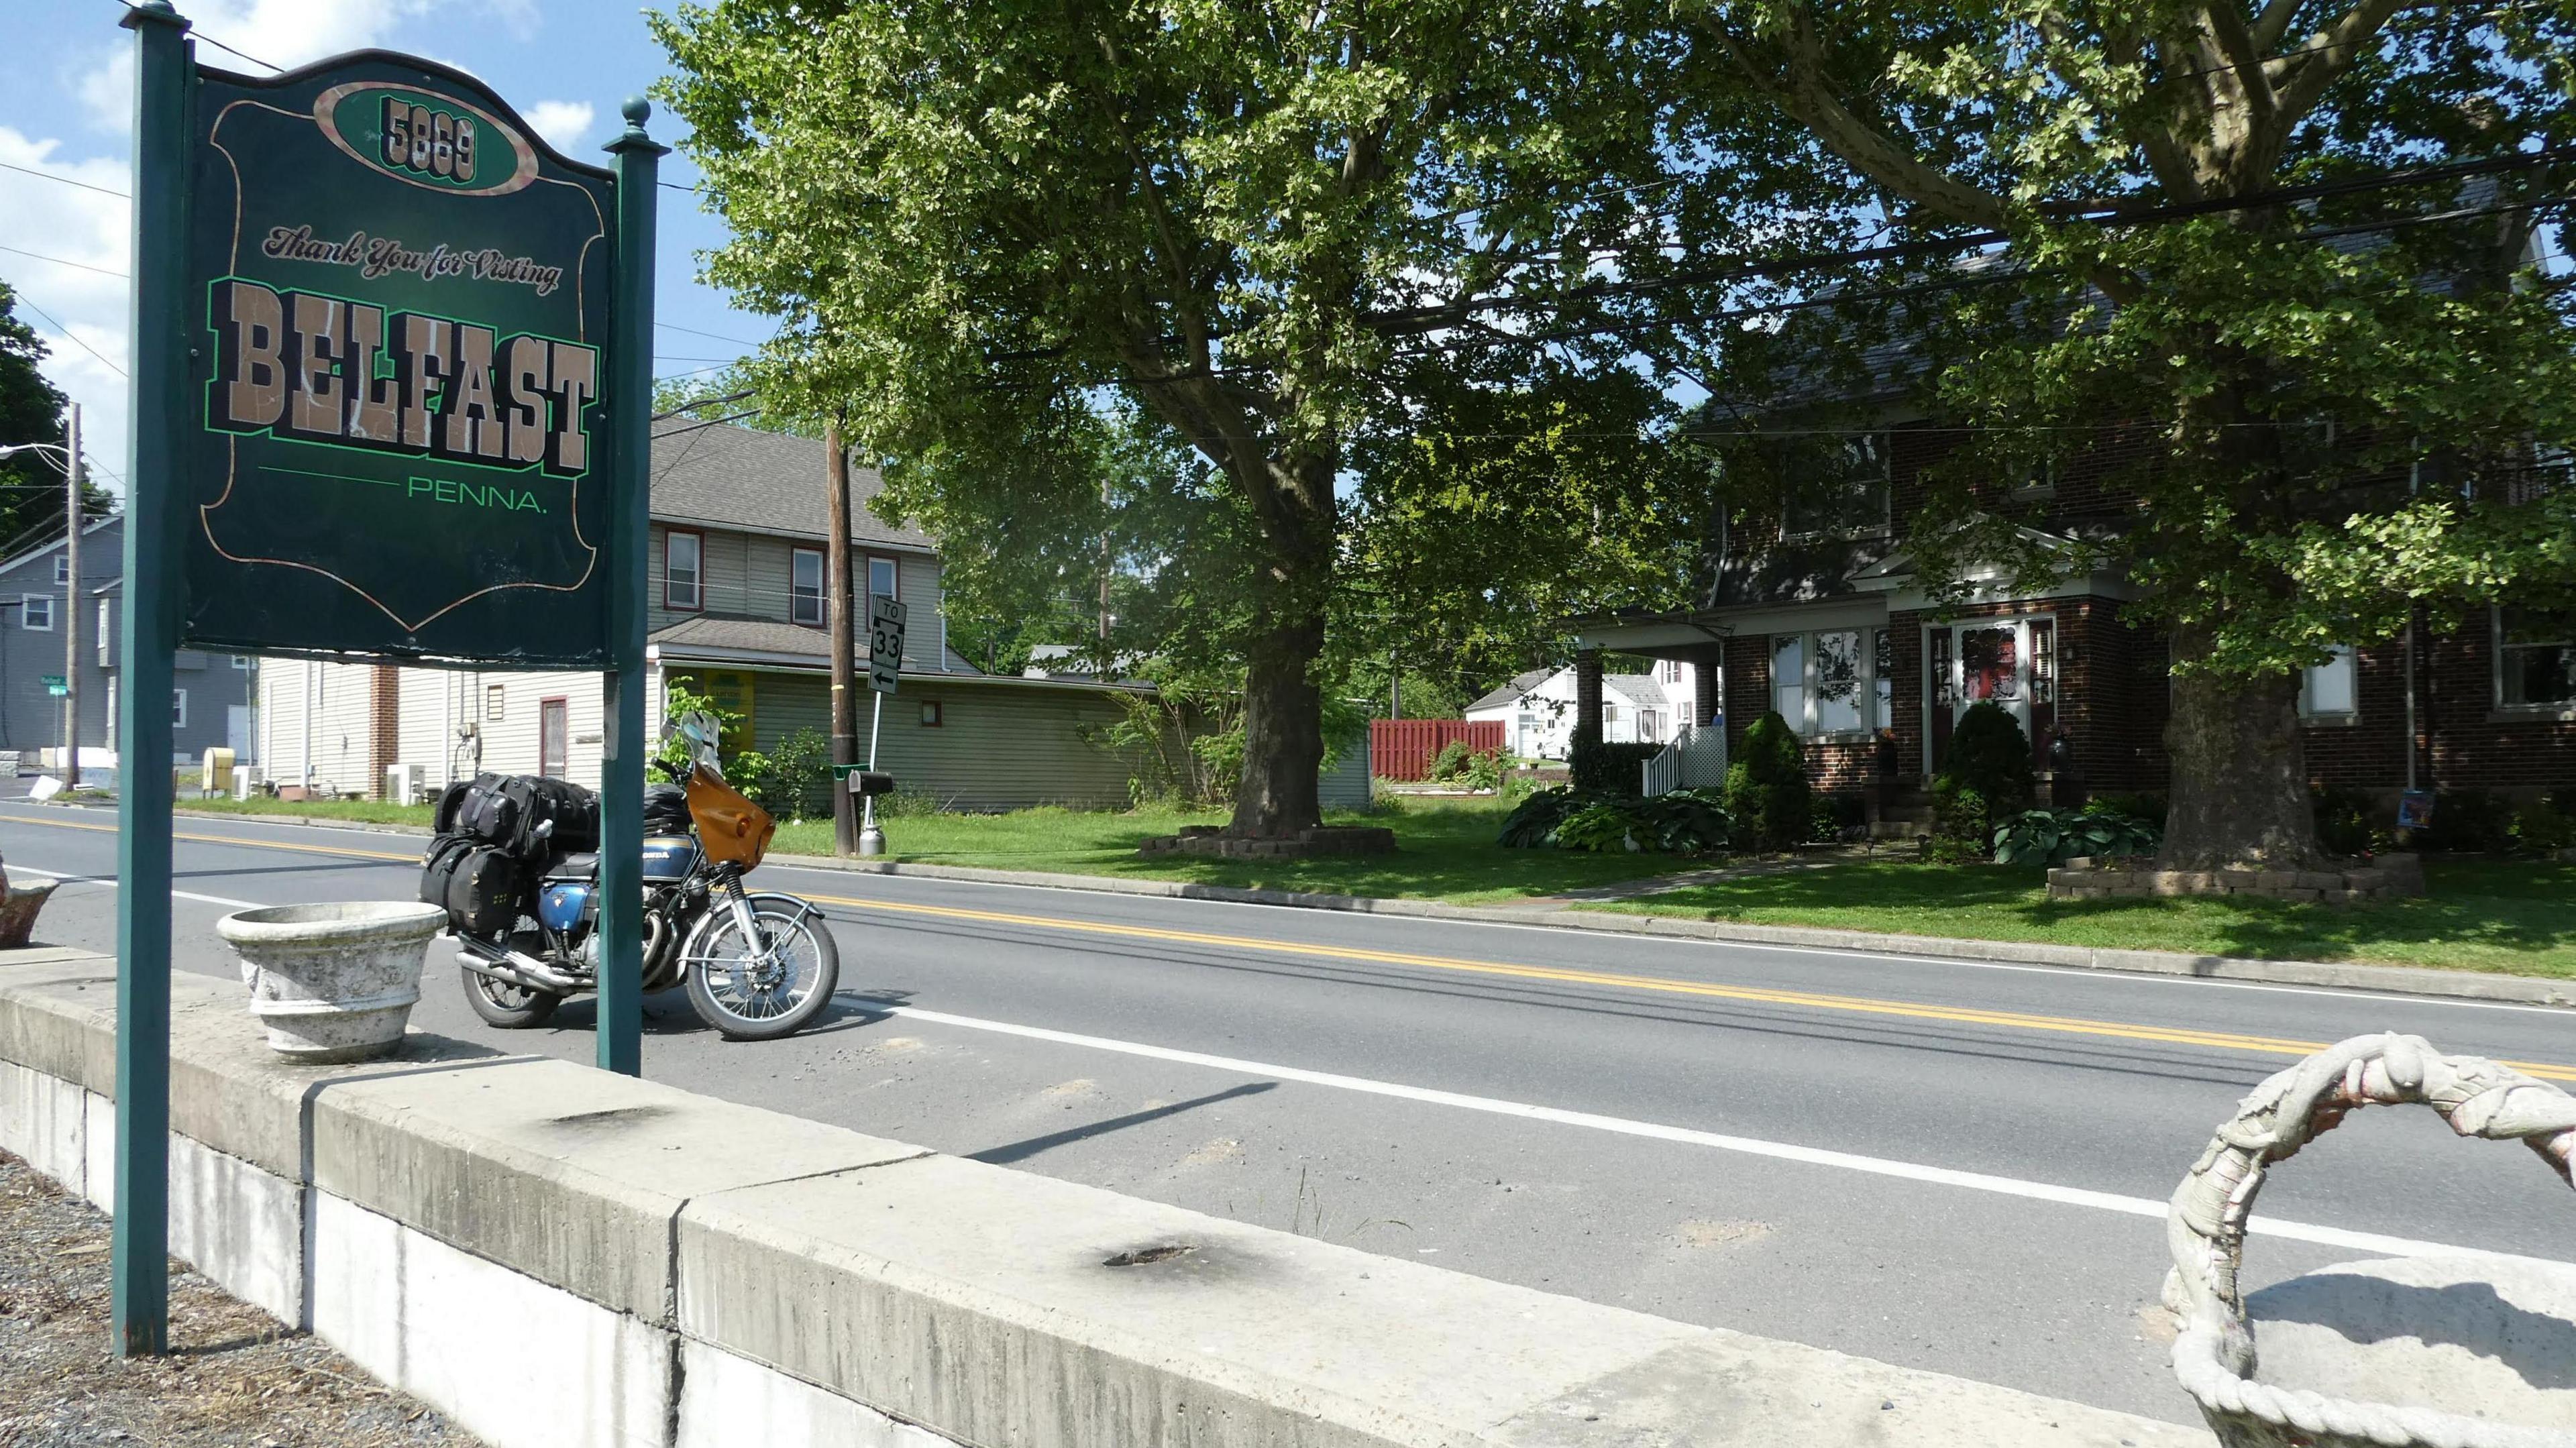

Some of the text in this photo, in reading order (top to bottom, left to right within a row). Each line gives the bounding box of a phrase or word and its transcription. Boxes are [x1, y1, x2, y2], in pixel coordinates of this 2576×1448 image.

[386, 99, 476, 181] 5869
[262, 224, 563, 296] Thank You for Visting
[219, 279, 597, 474] BELFAST
[408, 476, 548, 514] PENNA.
[883, 604, 898, 618] TO
[875, 630, 899, 658] 33
[642, 851, 670, 859] ONDA
